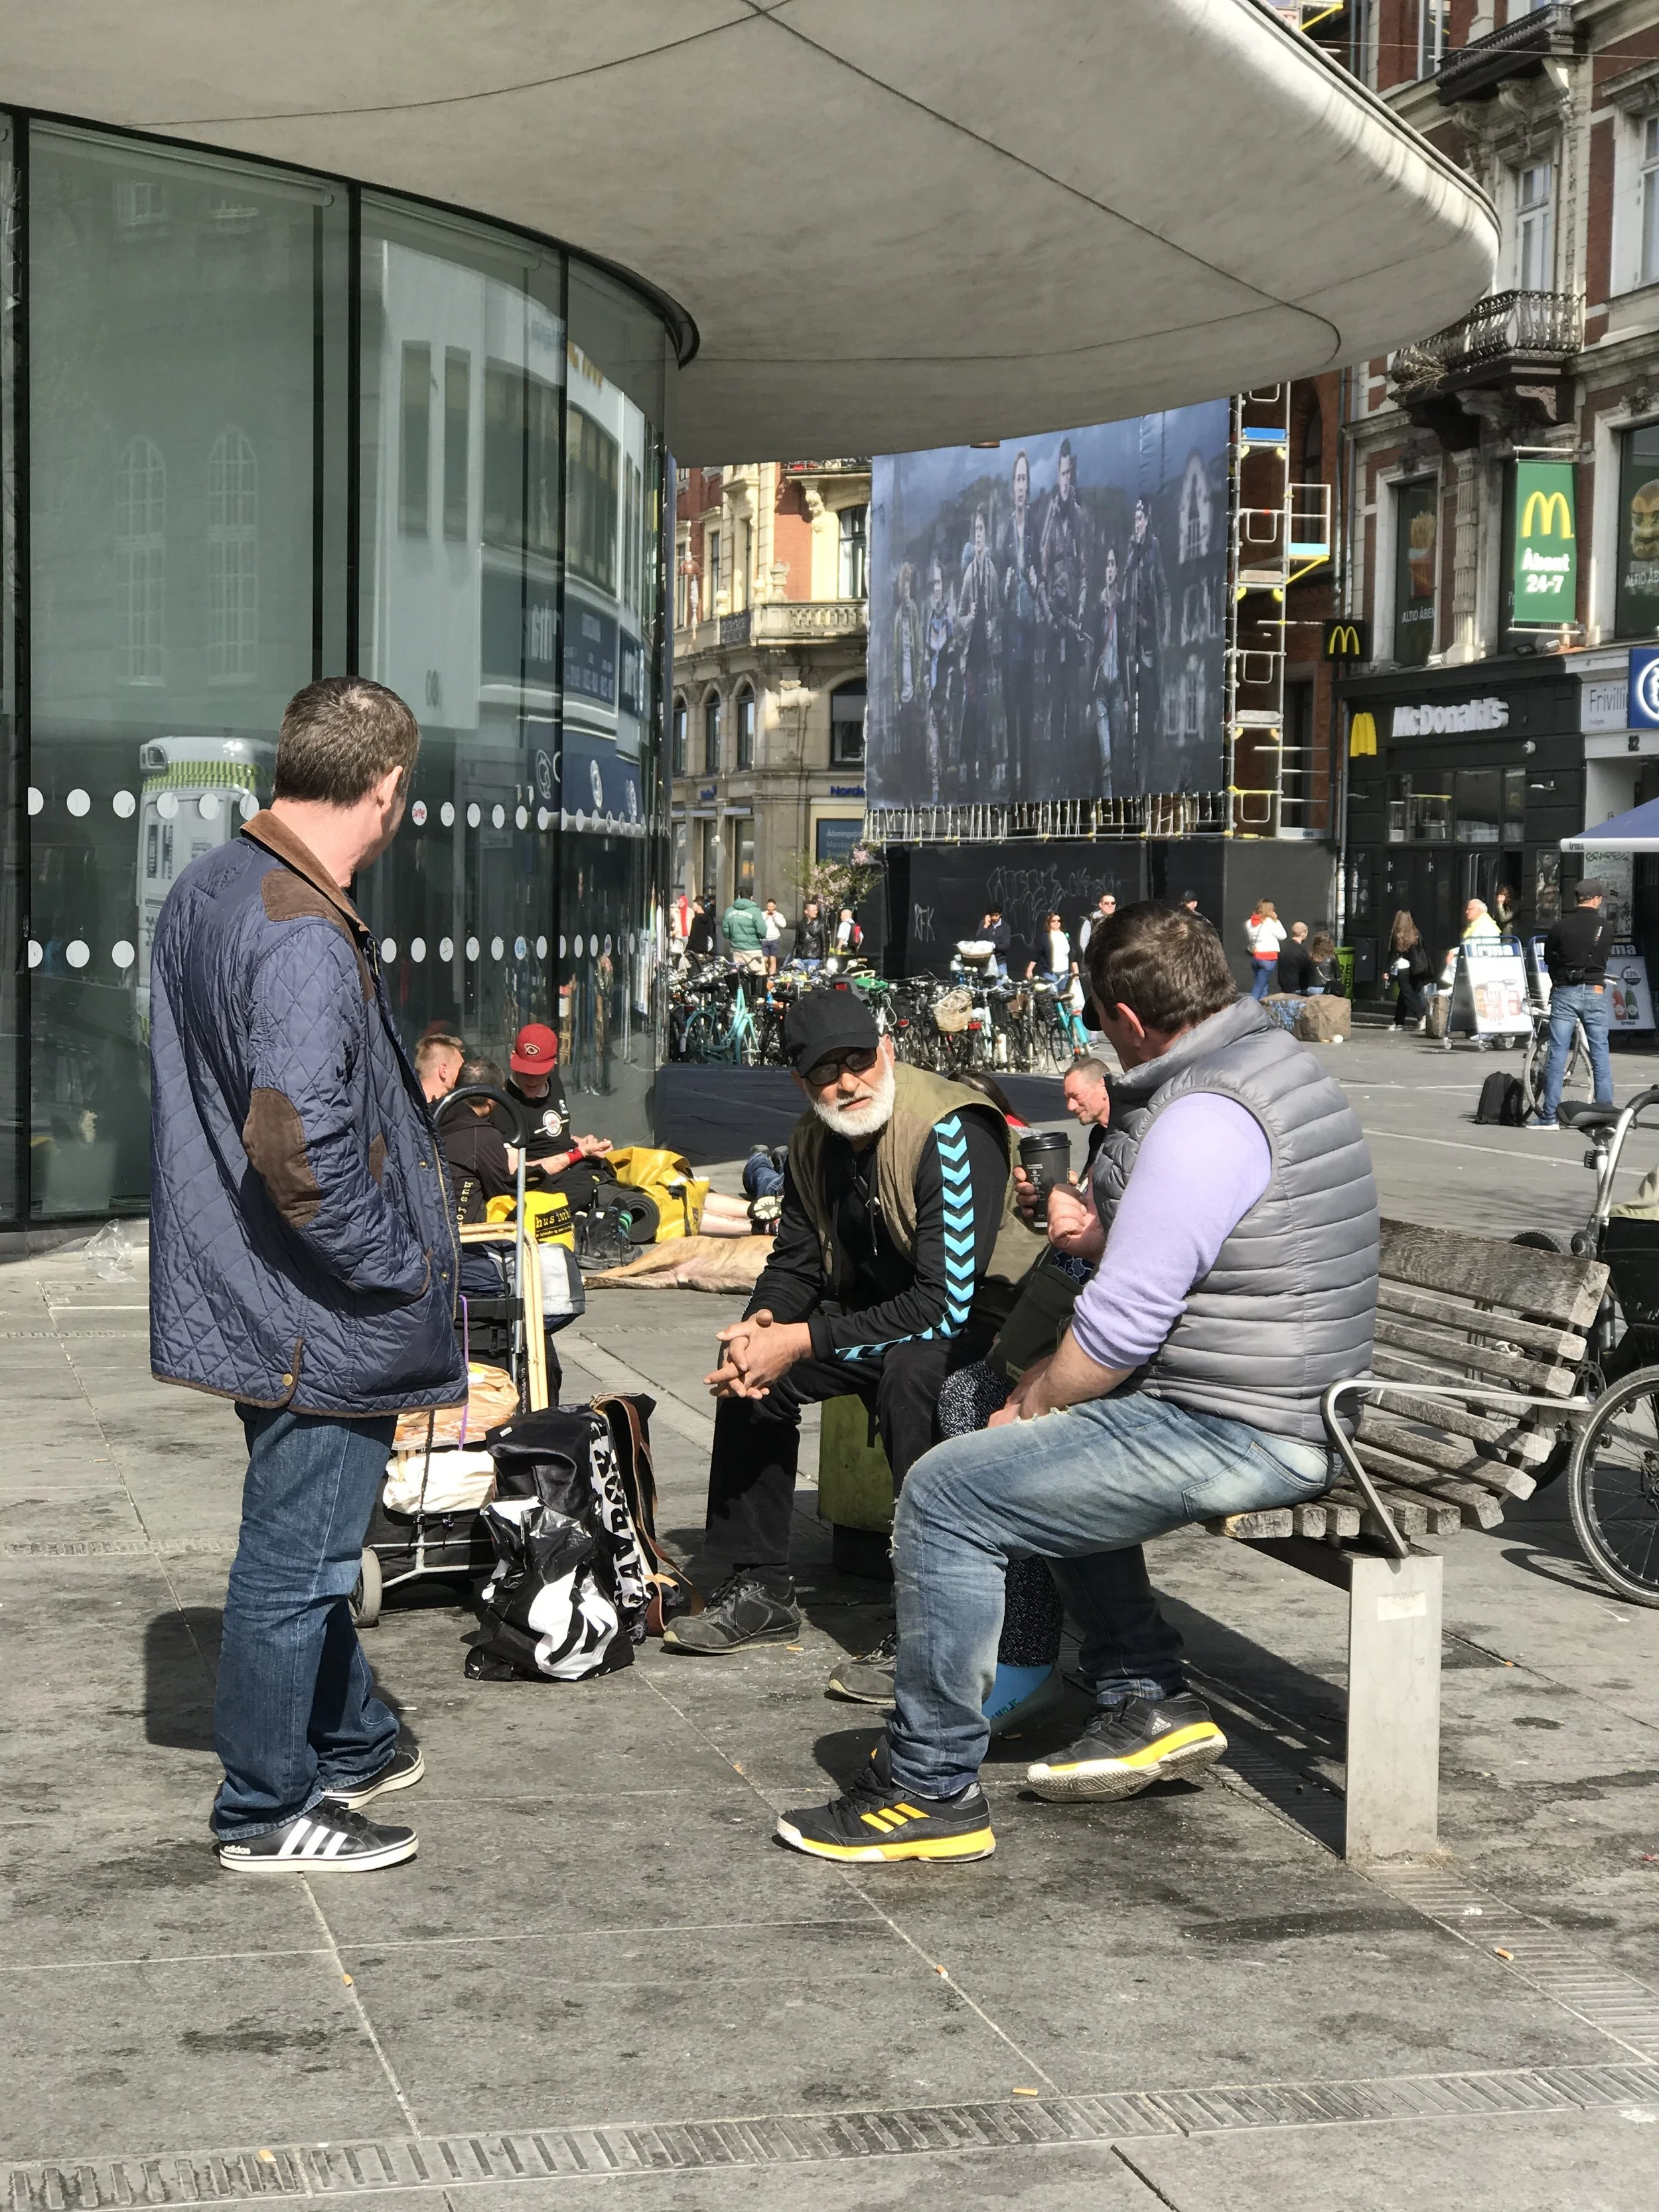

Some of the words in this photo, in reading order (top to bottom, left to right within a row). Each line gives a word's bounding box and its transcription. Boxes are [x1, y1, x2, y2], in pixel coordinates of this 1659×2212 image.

[1522, 548, 1570, 571] Åbent
[1526, 574, 1565, 593] 24-7
[1402, 609, 1419, 623] ALTID
[1392, 697, 1509, 737] McDonald's
[1628, 735, 1640, 752] 82
[460, 1181, 474, 1203] hus
[535, 1215, 555, 1228] hus
[1151, 1722, 1172, 1735] adidas
[224, 1844, 252, 1855] adidas
